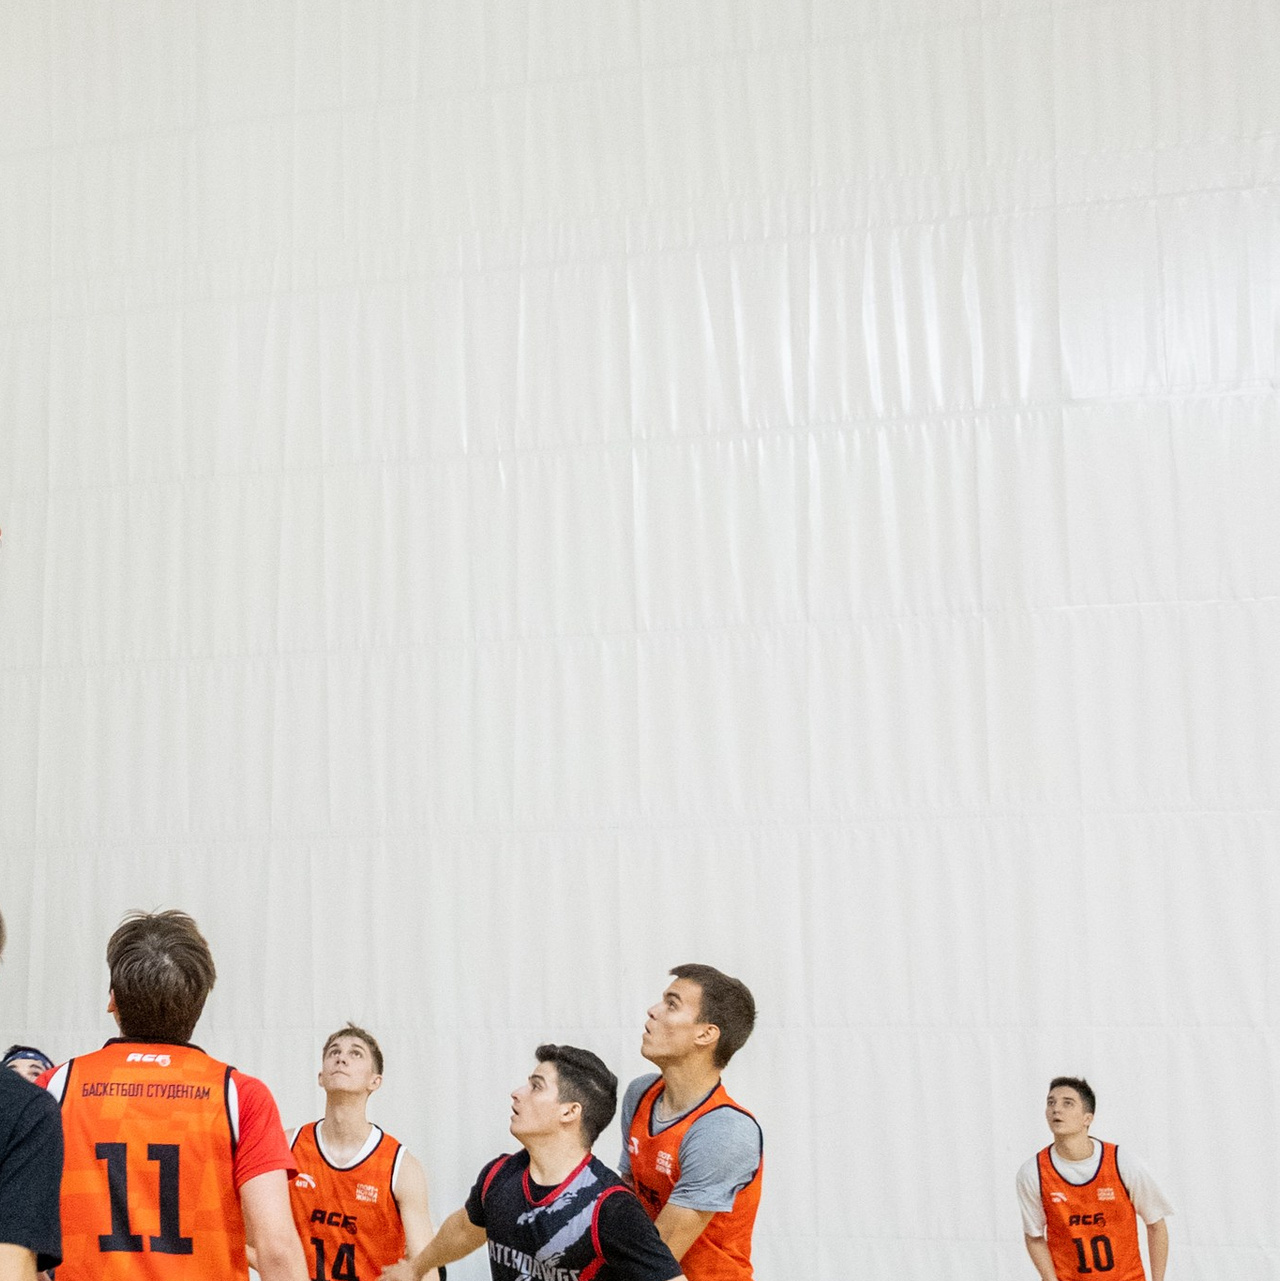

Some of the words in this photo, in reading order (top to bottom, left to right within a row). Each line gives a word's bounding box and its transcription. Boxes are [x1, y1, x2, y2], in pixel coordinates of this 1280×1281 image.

[82, 1082, 144, 1097] БАСКЕТБОЛ
[146, 1083, 211, 1100] СТУДЕНТАМ
[95, 1142, 193, 1255] 11
[1071, 1234, 1115, 1274] 10
